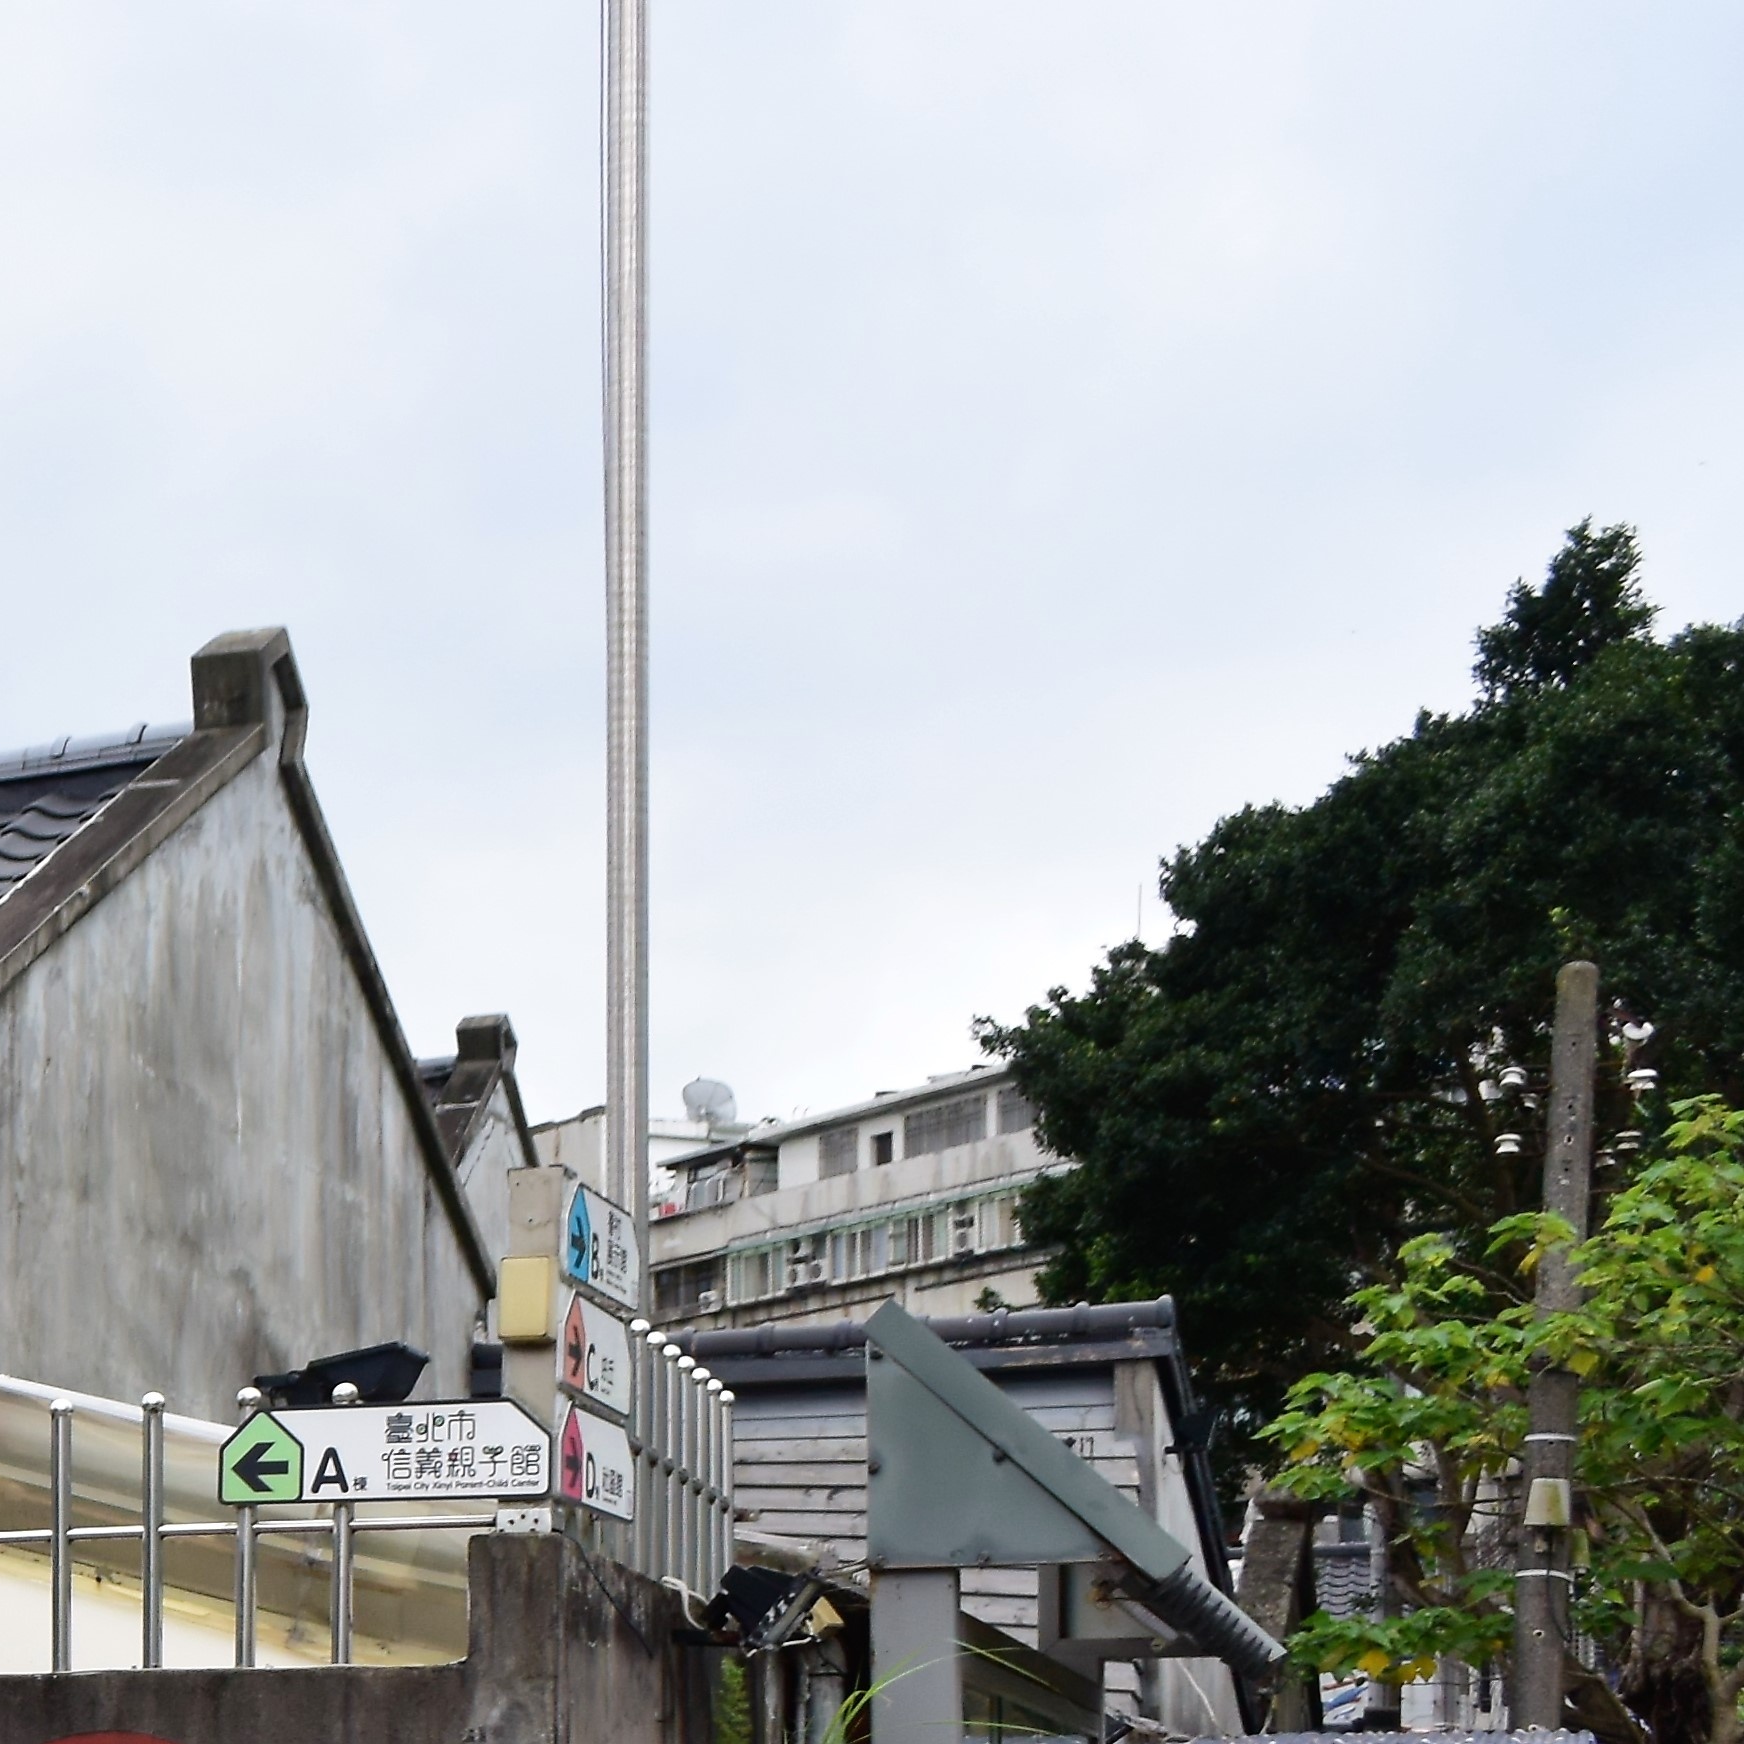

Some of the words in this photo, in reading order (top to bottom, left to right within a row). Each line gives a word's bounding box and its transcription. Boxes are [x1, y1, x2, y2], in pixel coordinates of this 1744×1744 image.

[385, 1410, 476, 1444] 臺北市
[381, 1445, 541, 1480] 信義親子館
[386, 1482, 411, 1491] Taipei
[414, 1481, 429, 1491] City
